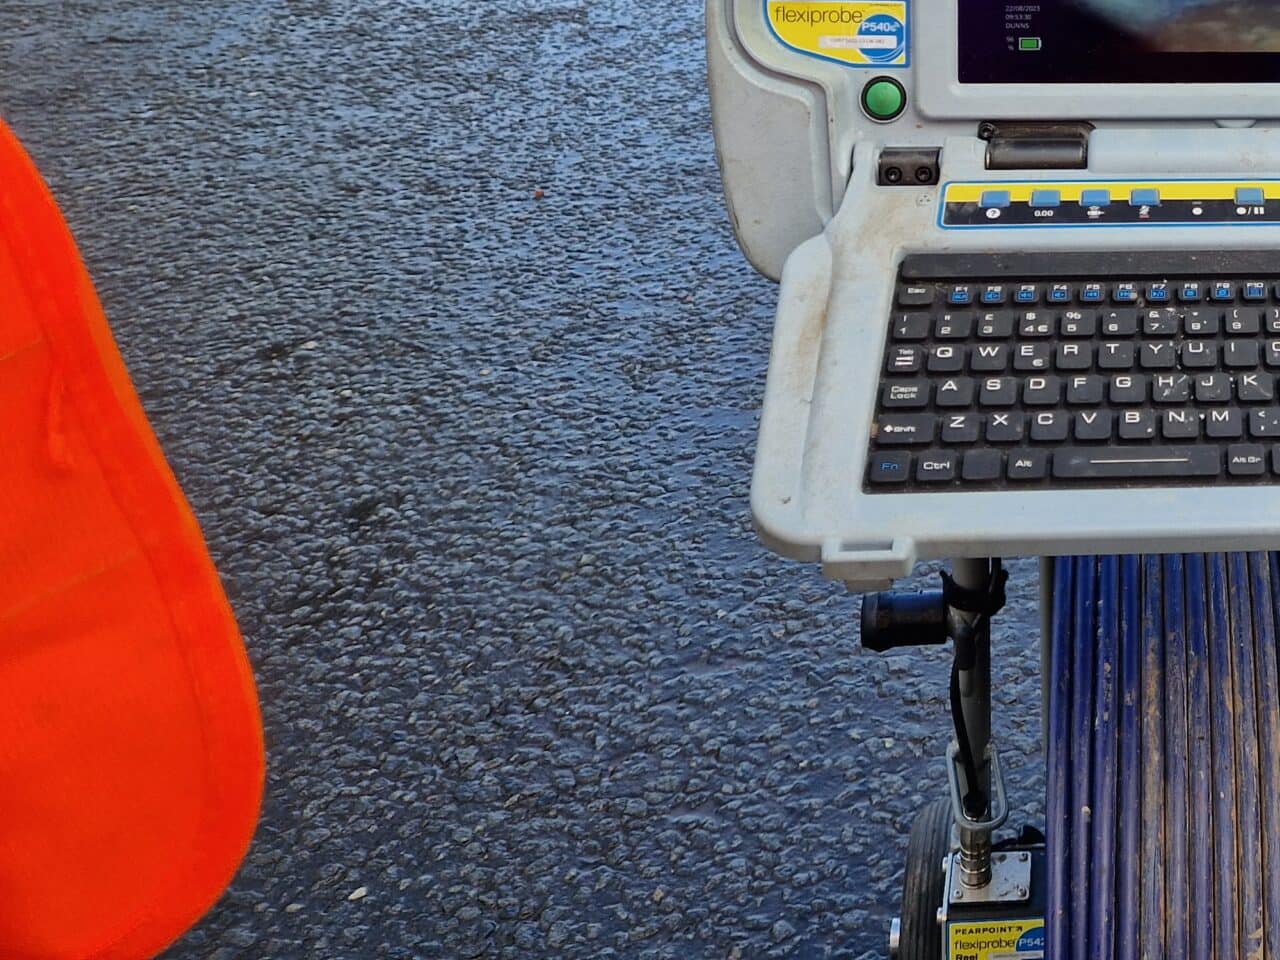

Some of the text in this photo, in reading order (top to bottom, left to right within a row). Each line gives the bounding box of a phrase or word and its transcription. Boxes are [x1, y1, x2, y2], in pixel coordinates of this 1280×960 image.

[775, 6, 863, 27] flexiprobe
[1034, 209, 1054, 217] 0.00
[899, 327, 907, 335] 1
[940, 326, 952, 335] 2
[982, 325, 994, 334] 3
[1023, 324, 1034, 333] 4
[1066, 323, 1077, 332] 5
[1108, 323, 1119, 332] 6
[1149, 322, 1161, 331] 7
[1191, 321, 1202, 331] 8
[1231, 321, 1242, 330] 9
[935, 346, 954, 358] Q
[978, 345, 1001, 358] W
[1020, 344, 1035, 356] E
[1063, 344, 1079, 356] R
[1105, 343, 1120, 354] T
[1148, 343, 1164, 355] Y
[1188, 342, 1204, 354] U
[940, 379, 958, 392] A
[985, 378, 1002, 391] S
[1029, 377, 1046, 390] D
[1073, 376, 1087, 389] F
[1115, 376, 1132, 388] G
[1158, 375, 1174, 388] H
[1200, 375, 1214, 387] J
[1243, 374, 1259, 387] K
[890, 385, 918, 393] Caps
[889, 392, 918, 400] Lock
[949, 415, 966, 428] Z
[992, 413, 1009, 426] X
[1037, 412, 1054, 425] C
[1081, 411, 1098, 424] V
[1124, 410, 1141, 424] B
[1168, 410, 1185, 423] N
[1211, 409, 1230, 422] M
[923, 460, 951, 470] Ctrl
[1014, 459, 1033, 468] Alt
[1231, 455, 1262, 463] Alt Gr
[881, 462, 899, 471] Fn
[955, 926, 1012, 935] PEARPOINT
[954, 937, 1015, 951] flexiprobe
